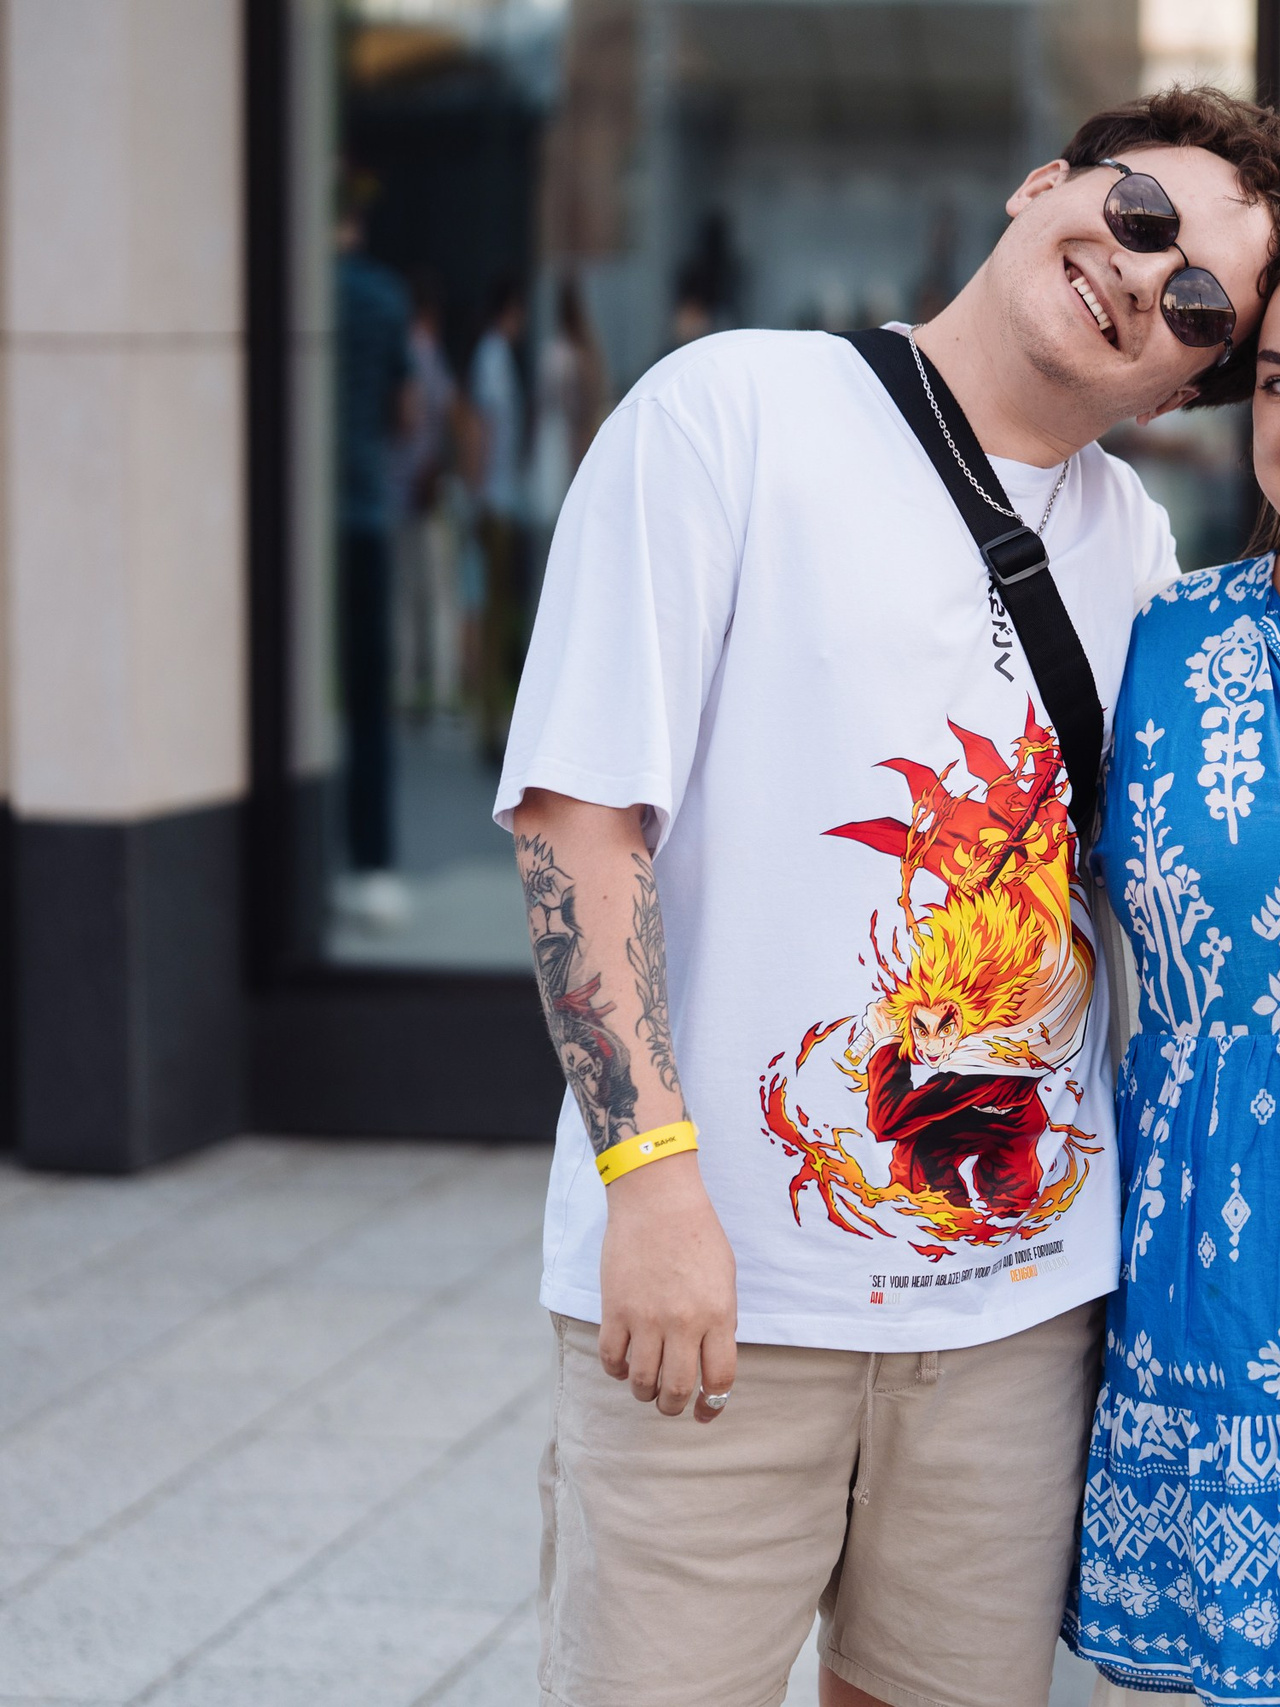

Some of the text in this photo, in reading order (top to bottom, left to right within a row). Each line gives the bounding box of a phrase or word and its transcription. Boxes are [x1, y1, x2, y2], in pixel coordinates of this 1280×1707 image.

[654, 1136, 677, 1148] БАНК
[890, 1275, 909, 1288] YOUR
[911, 1274, 933, 1288] HEART
[975, 1265, 991, 1279] YOUR
[1003, 1254, 1013, 1268] AND
[1014, 1248, 1033, 1264] MOVE
[1010, 1264, 1038, 1283] RENGOKU
